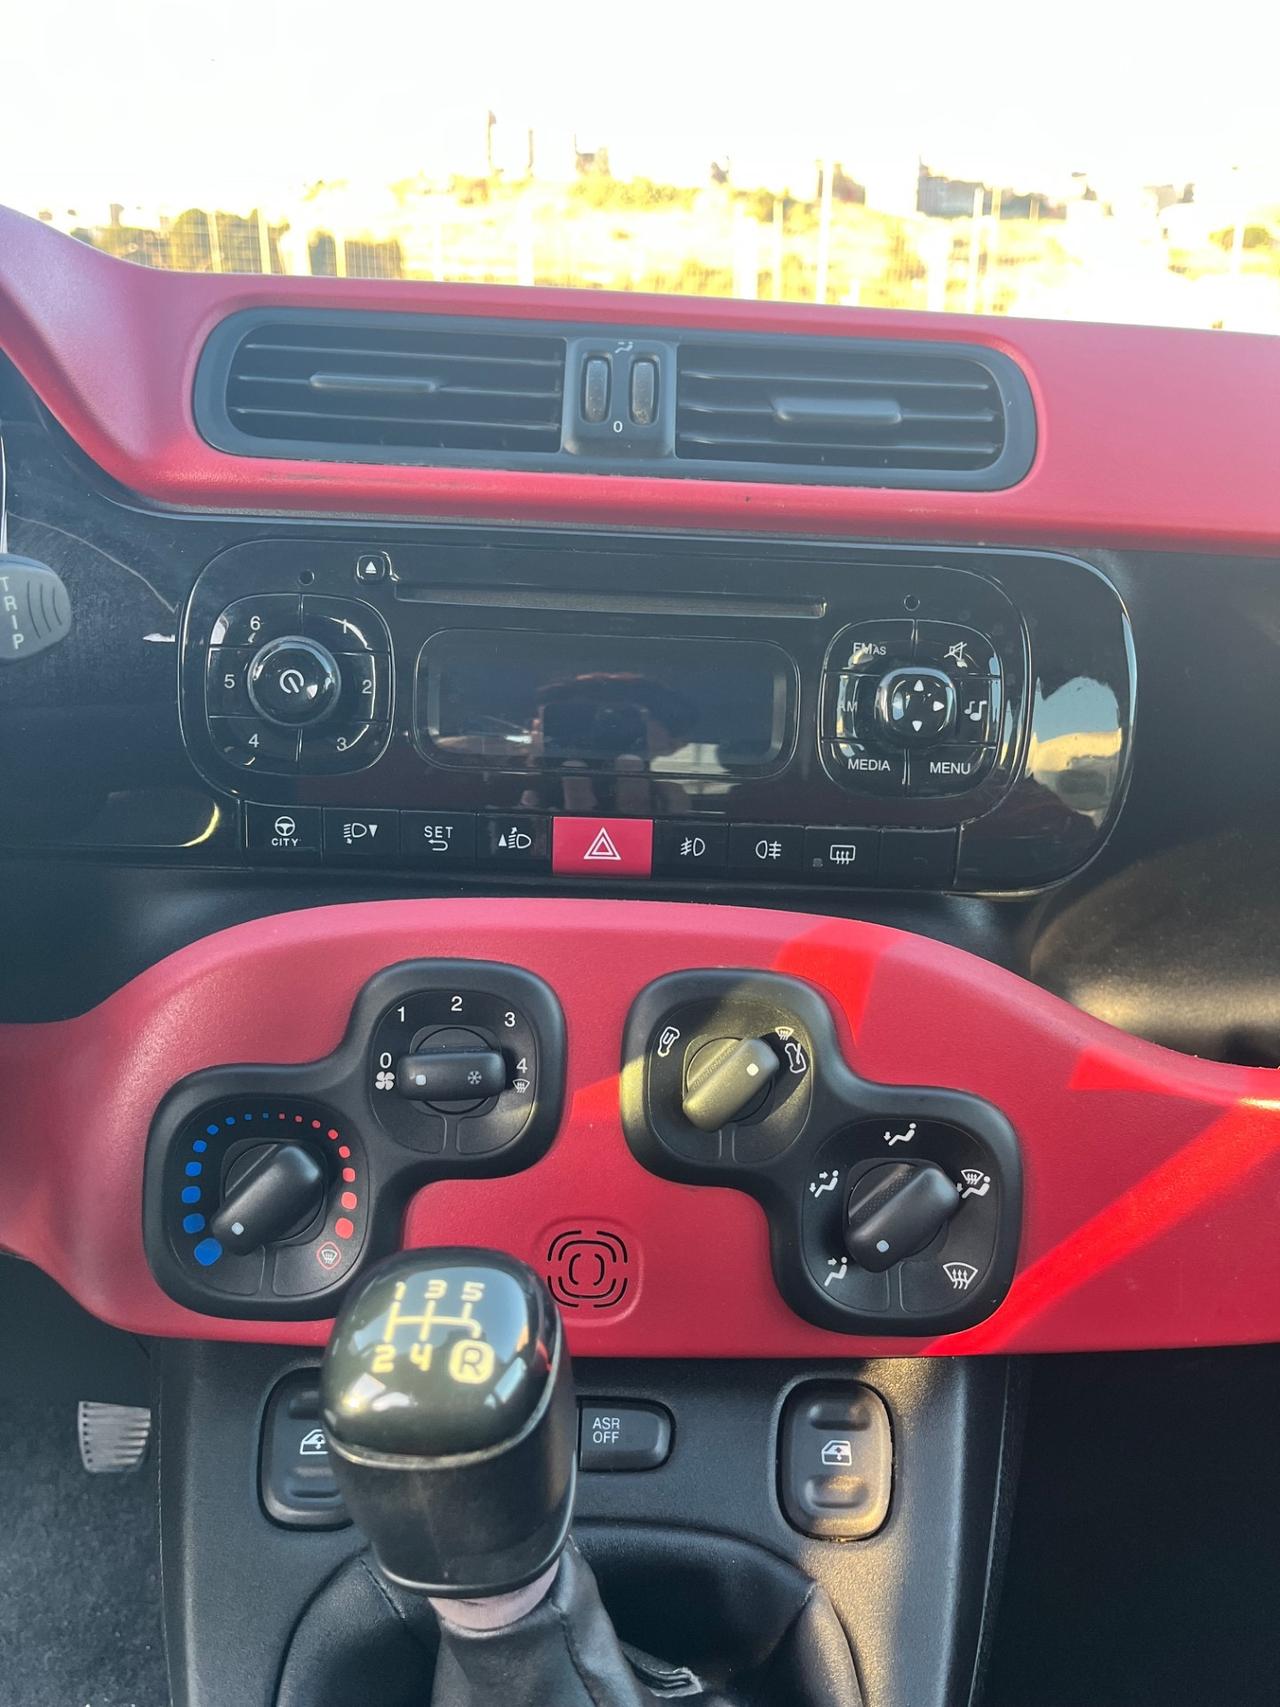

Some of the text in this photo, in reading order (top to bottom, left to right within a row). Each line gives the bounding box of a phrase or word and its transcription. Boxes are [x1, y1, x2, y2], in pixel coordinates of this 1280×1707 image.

[0, 576, 24, 650] TRIP
[249, 616, 261, 631] 6
[224, 674, 236, 689] 5
[361, 680, 373, 695] 2
[248, 733, 260, 748] 4
[336, 737, 348, 752] 3
[847, 758, 891, 772] MEDIA
[929, 761, 972, 775] MENU
[423, 825, 454, 839] SET
[271, 837, 299, 847] CITY
[450, 996, 463, 1012] 2
[397, 1006, 406, 1022] 1
[504, 1012, 516, 1028] 3
[379, 1052, 393, 1069] 0
[516, 1057, 528, 1074] 4
[395, 1279, 485, 1301] 1 3 5
[371, 1343, 482, 1376] 2 4 R
[592, 1416, 620, 1430] ASR
[592, 1431, 620, 1444] OFF
